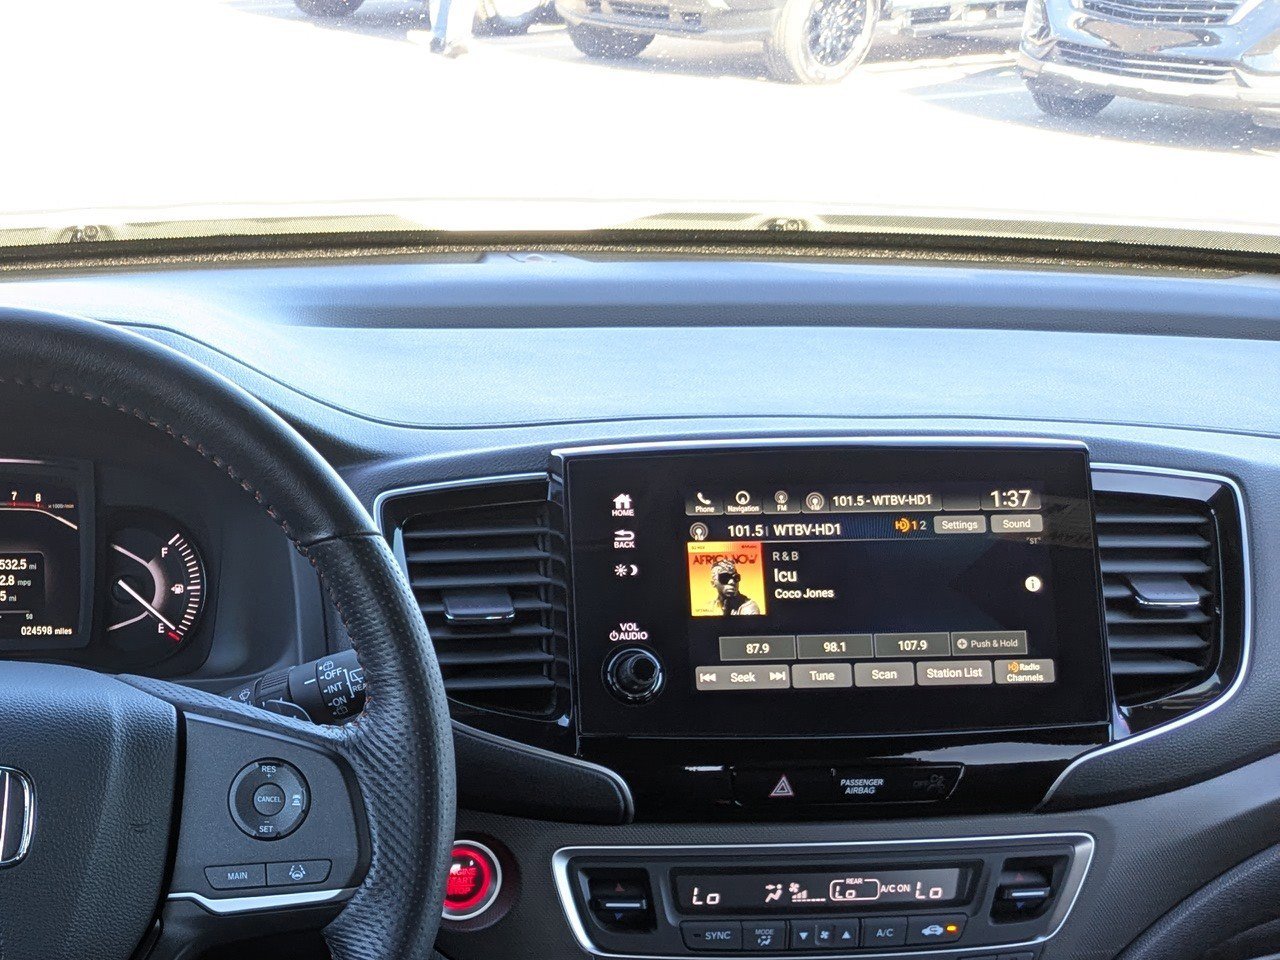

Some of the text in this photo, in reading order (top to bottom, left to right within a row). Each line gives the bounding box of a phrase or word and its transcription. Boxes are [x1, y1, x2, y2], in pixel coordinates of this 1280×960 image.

[11, 492, 17, 500] 7
[36, 493, 41, 502] 8
[832, 495, 864, 506] 101.5
[872, 493, 932, 507] WTBV-HD1
[990, 489, 1031, 508] 1:37
[612, 509, 634, 517] HOME
[727, 505, 759, 513] Navigation
[942, 520, 978, 530] Settings
[1003, 519, 1031, 528] Sound
[728, 523, 841, 537] 101.5 WTBV-HD1
[161, 547, 168, 558] F
[772, 552, 780, 561] R
[792, 551, 799, 560] B
[775, 588, 834, 599] Coco Jones
[21, 627, 52, 635] 024598
[158, 623, 165, 633] E
[620, 622, 639, 631] VOL
[619, 632, 648, 640] AUDIO
[746, 643, 769, 654] 87.9
[824, 641, 846, 653] 98.1
[898, 640, 928, 651] 107.9
[971, 640, 990, 648] Push
[1000, 639, 1018, 647] Hold
[1020, 663, 1040, 671] Radio
[324, 667, 342, 680] OFF
[731, 672, 755, 683] Seek
[809, 671, 835, 680] Tune
[872, 670, 897, 679] Scan
[927, 668, 982, 678] Station List
[1007, 674, 1044, 682] Channels
[327, 682, 343, 694] INT
[333, 696, 347, 707] ON
[261, 765, 277, 773] RES
[228, 872, 248, 880] MAIN
[880, 884, 910, 893] A/C ON
[705, 931, 731, 940] SYNC
[876, 929, 894, 937] A/C
